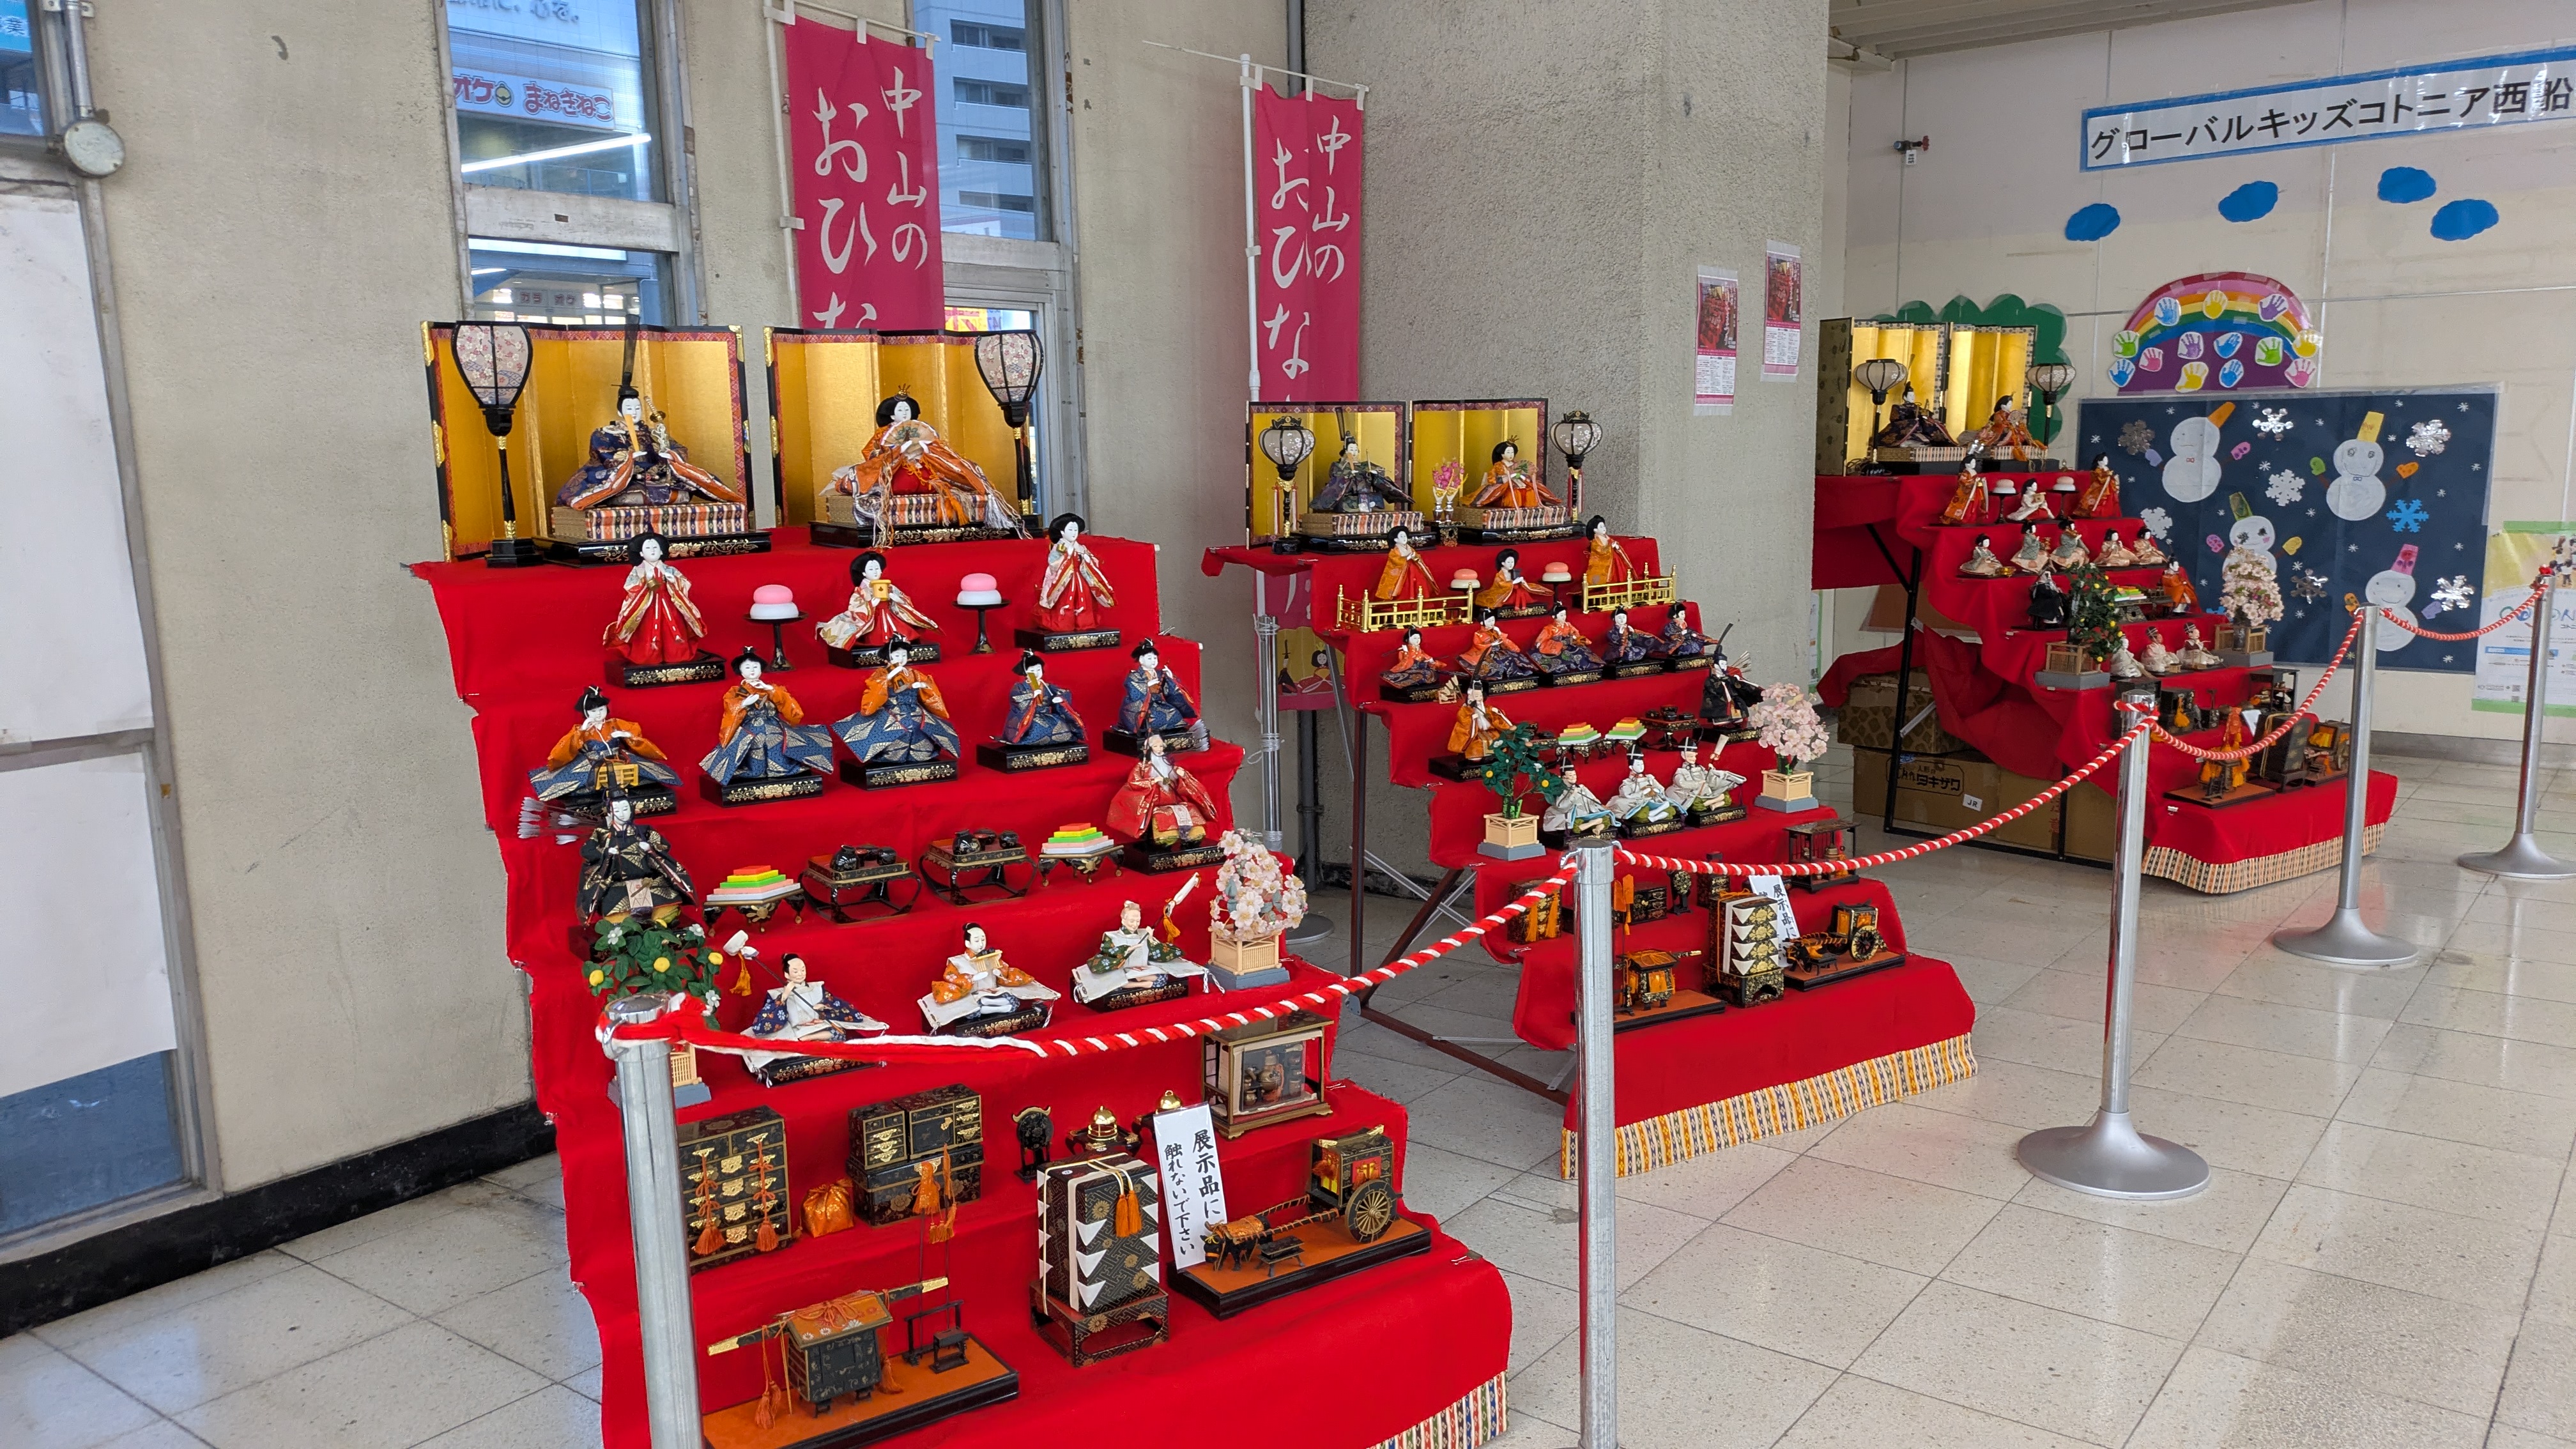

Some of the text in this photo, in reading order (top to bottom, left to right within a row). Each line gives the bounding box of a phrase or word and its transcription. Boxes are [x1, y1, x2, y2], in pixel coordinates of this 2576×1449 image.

[523, 81, 614, 121] まねきねこ
[2090, 76, 2574, 160] グローバルキッズコトニア西船
[881, 65, 927, 270] 中山の
[1312, 115, 1351, 284] 中山の
[1262, 137, 1311, 401] おひな
[1772, 884, 1797, 938] 展示品に
[1164, 1143, 1195, 1255] 触れないで下さい
[1193, 1128, 1221, 1219] 展示品に
